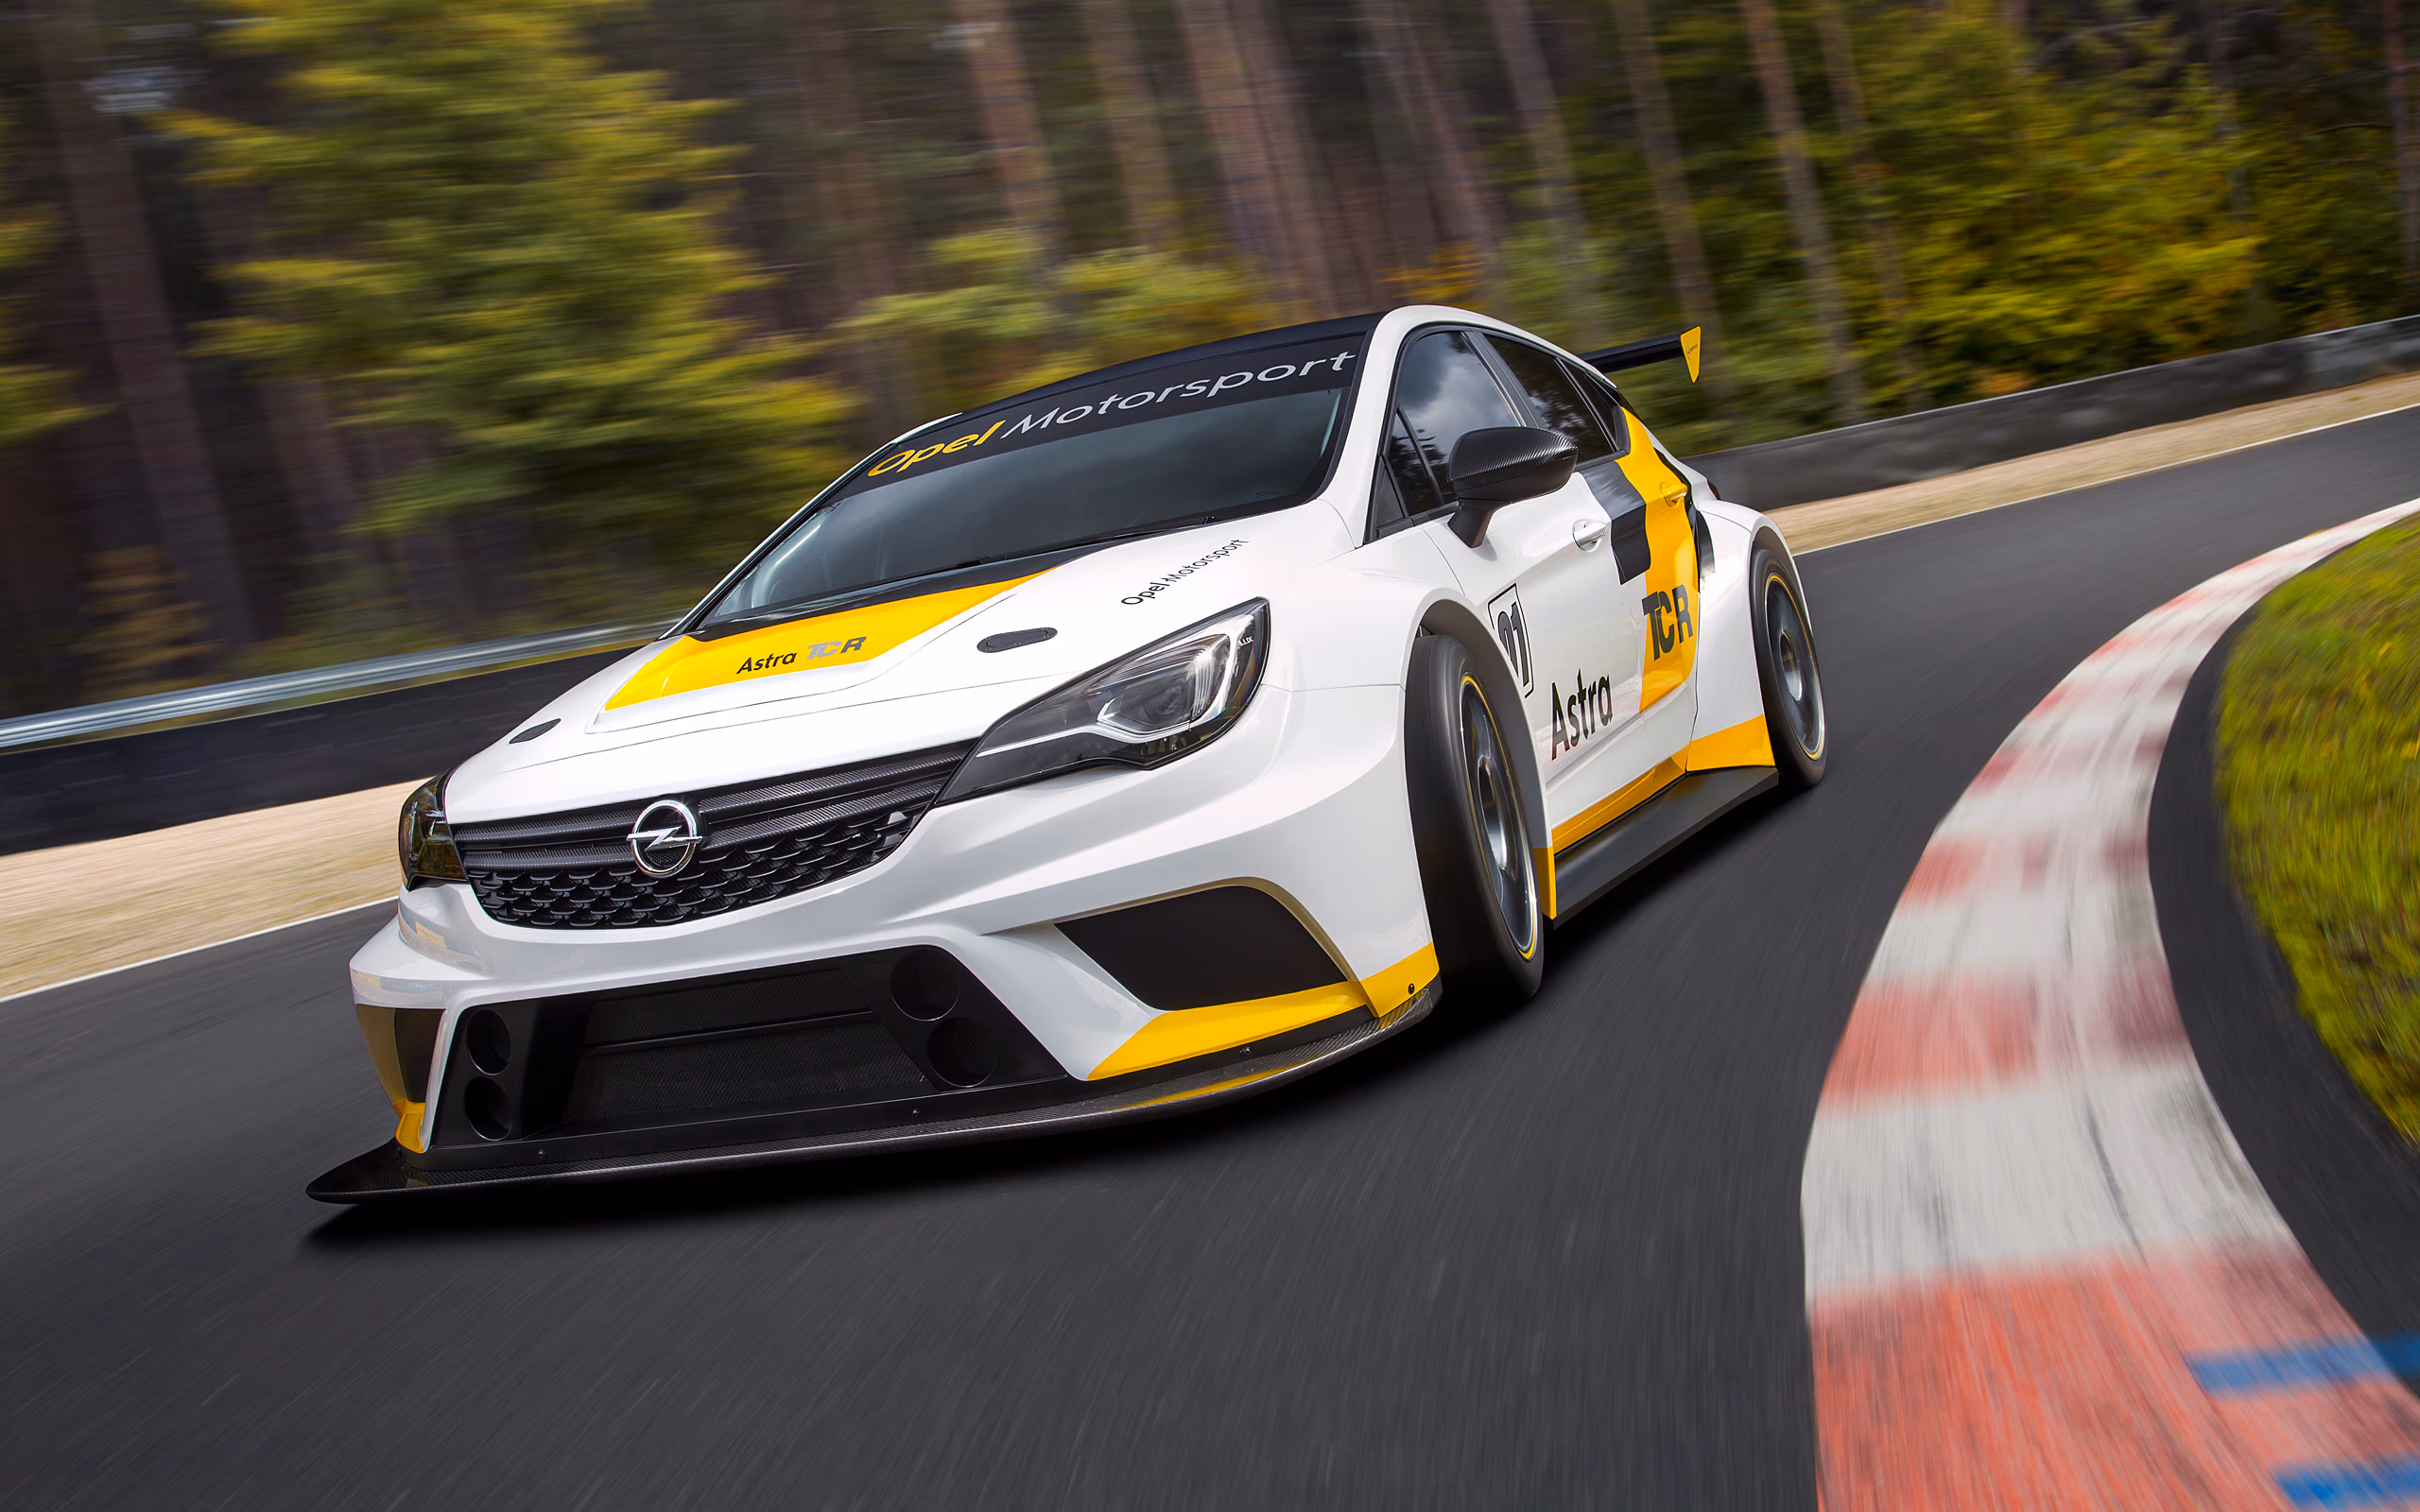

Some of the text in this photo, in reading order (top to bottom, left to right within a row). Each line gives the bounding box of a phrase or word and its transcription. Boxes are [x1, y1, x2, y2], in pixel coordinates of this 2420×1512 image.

[868, 351, 1357, 477] Opel Motorsport
[1120, 540, 1251, 605] Opel Motorsport
[1641, 584, 1694, 662] TCR
[736, 652, 798, 675] Astra
[1551, 668, 1614, 761] Astra
